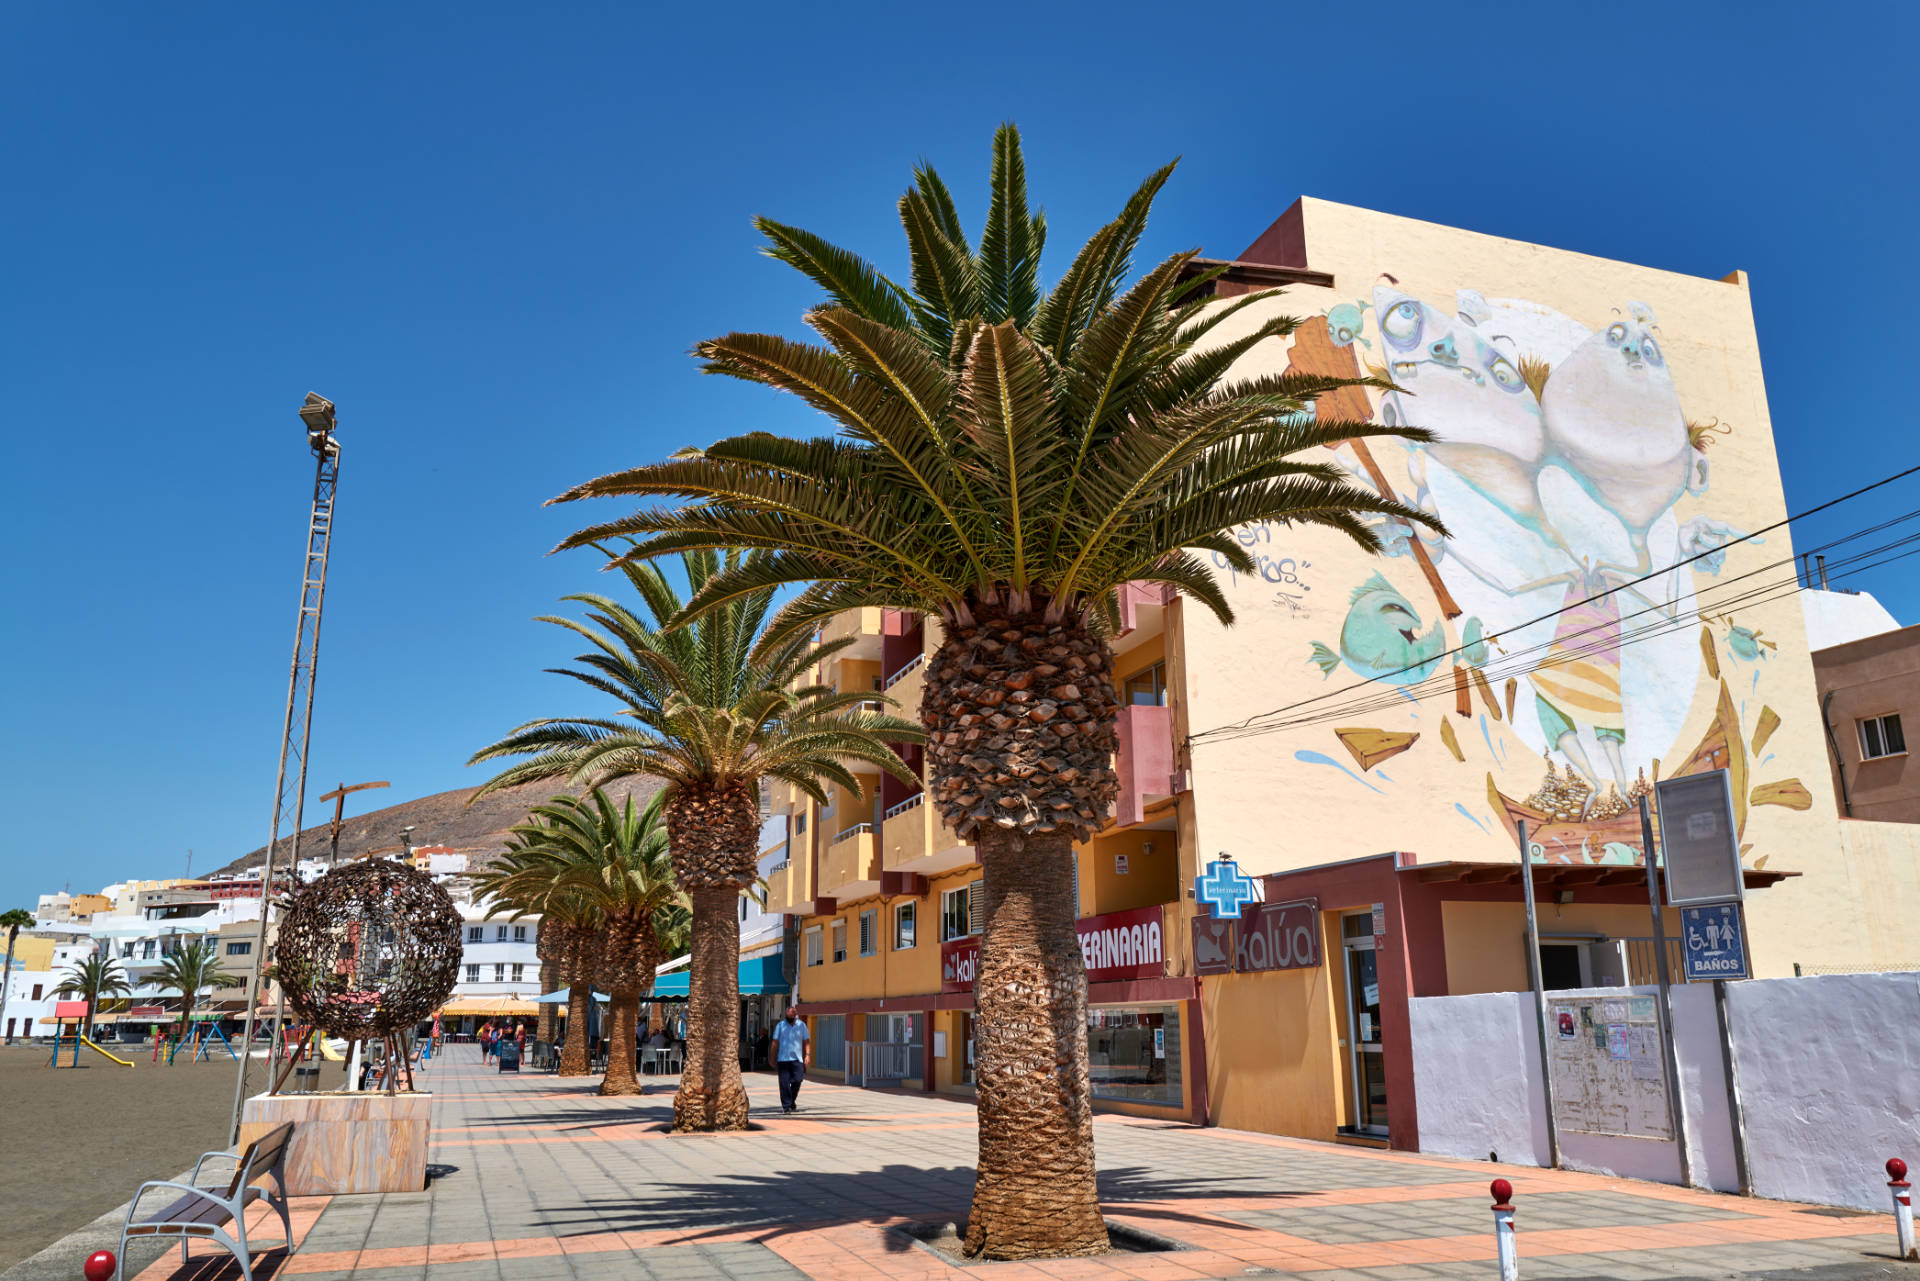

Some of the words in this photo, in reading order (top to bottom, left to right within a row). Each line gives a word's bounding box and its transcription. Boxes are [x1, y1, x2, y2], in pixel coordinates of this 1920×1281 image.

[1237, 525, 1270, 547] en
[1233, 911, 1313, 970] kalúa
[1694, 957, 1739, 971] BAÑOS
